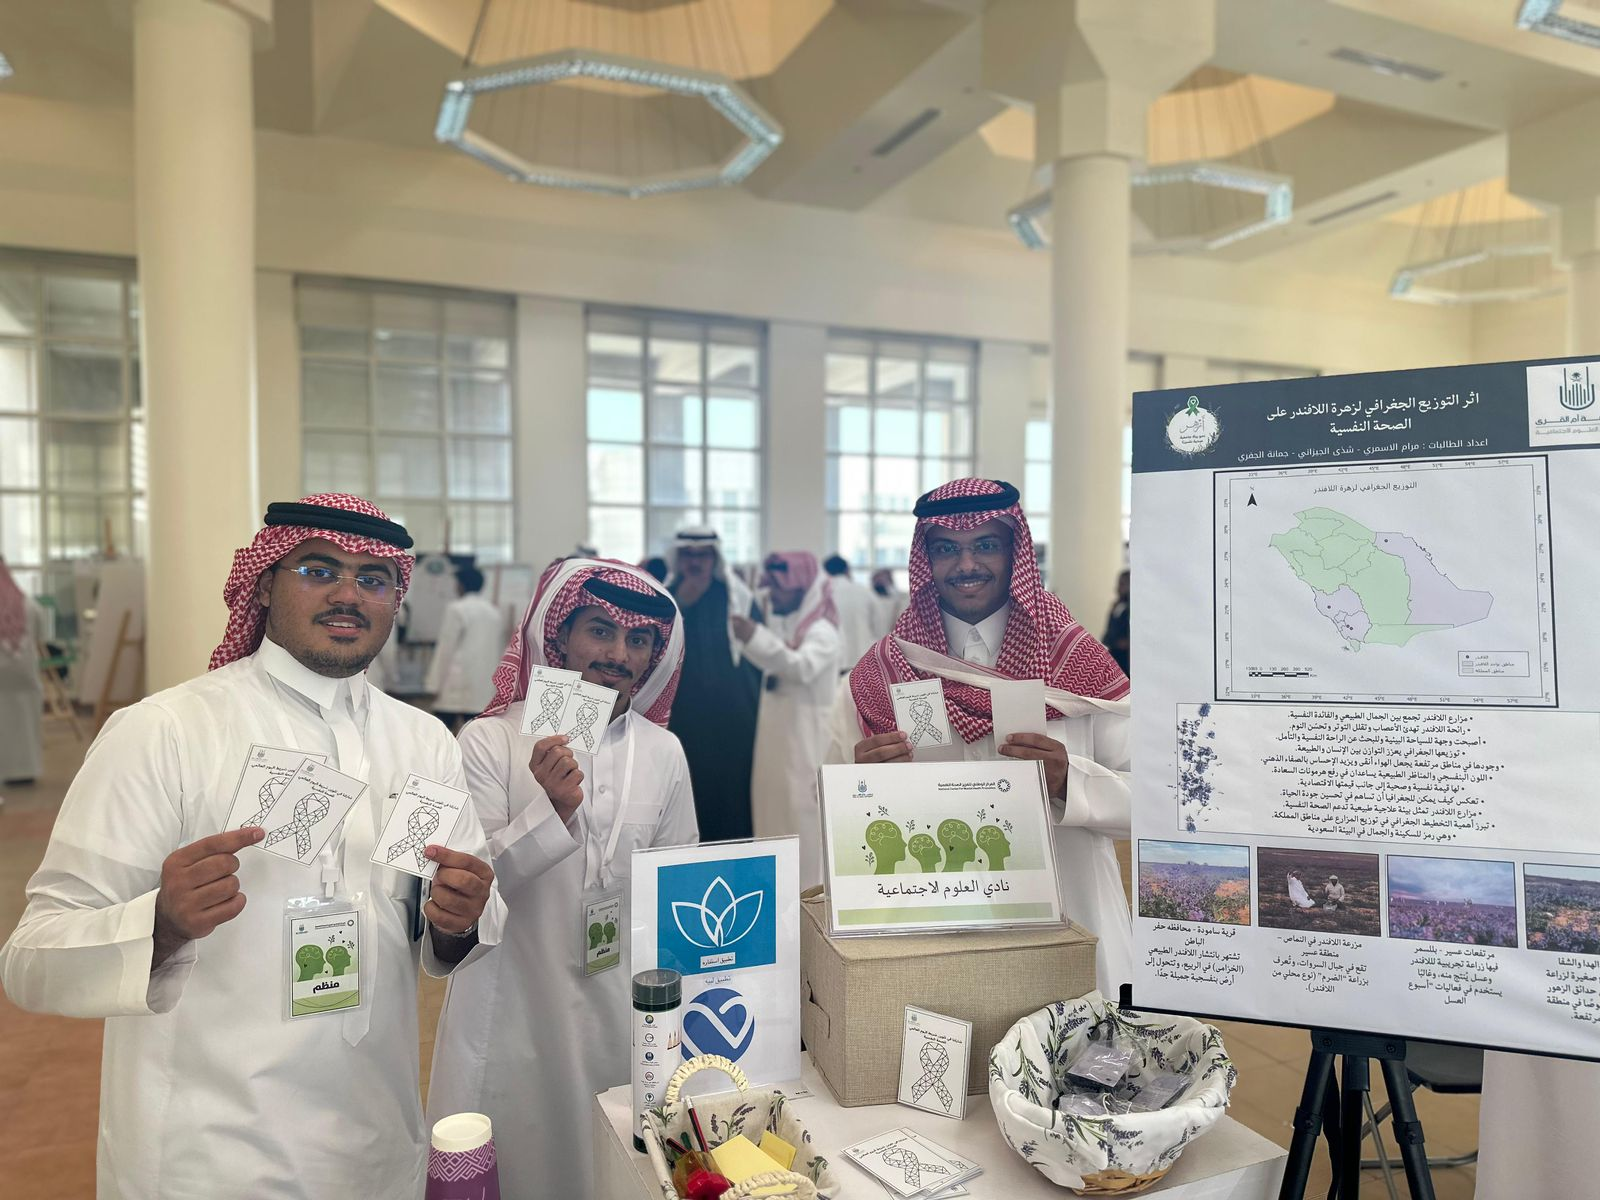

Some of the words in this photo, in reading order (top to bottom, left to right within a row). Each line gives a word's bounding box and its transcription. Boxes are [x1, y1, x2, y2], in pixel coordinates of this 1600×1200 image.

[1418, 394, 1458, 412] التوزيع
[1462, 391, 1478, 408] اثر
[1267, 406, 1286, 420] على
[1290, 403, 1328, 419] اللافندر
[1331, 400, 1361, 416] لزهرة
[1364, 397, 1415, 417] الجغرافي
[1330, 420, 1370, 435] النفسية
[1373, 418, 1411, 430] الصحة
[1401, 442, 1419, 452] مرام
[1428, 439, 1462, 449] الطالبات
[1466, 438, 1487, 446] اعداد
[1238, 450, 1264, 462] الجفري
[1298, 447, 1329, 459] الجيزاني
[1332, 445, 1353, 456] شذى
[1363, 443, 1397, 456] الاسمري
[877, 880, 938, 897] الاجتماعية
[943, 879, 978, 899] العلوم
[983, 879, 1009, 897] نادي
[1283, 935, 1306, 943] النماص
[313, 981, 340, 993] منظم
